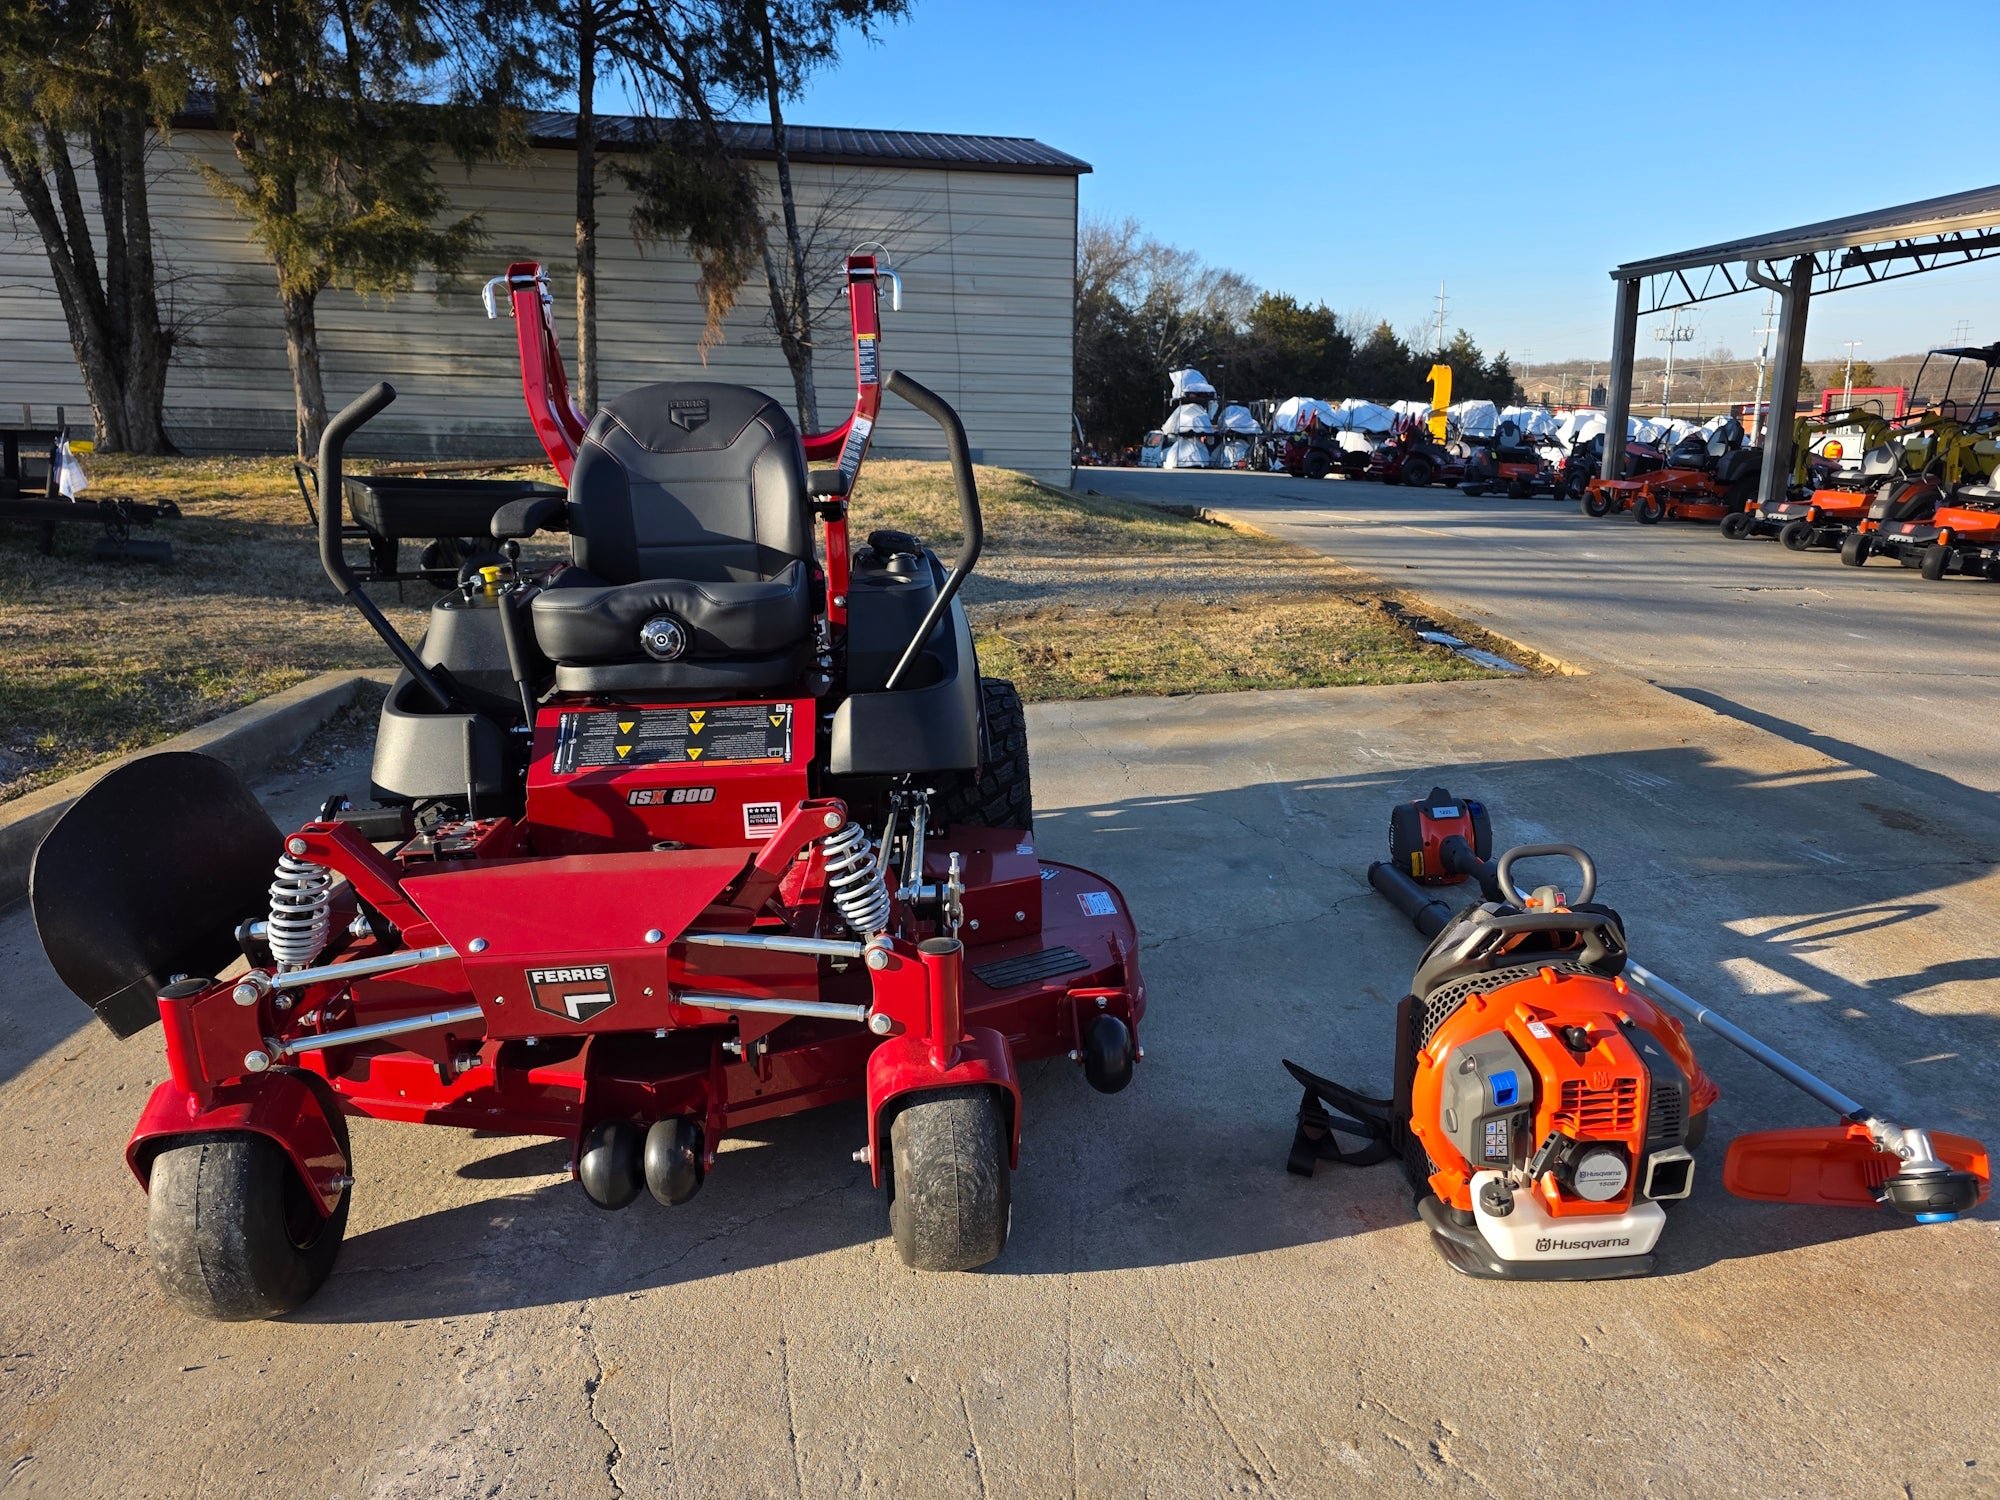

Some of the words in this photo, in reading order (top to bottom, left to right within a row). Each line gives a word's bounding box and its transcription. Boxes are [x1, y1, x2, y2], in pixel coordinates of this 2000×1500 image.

[629, 790, 667, 805] ISX
[671, 788, 714, 804] 800
[531, 967, 607, 984] FERRIS
[1586, 1170, 1622, 1178] Husqvarna
[1552, 1238, 1630, 1251] Husqvarna
